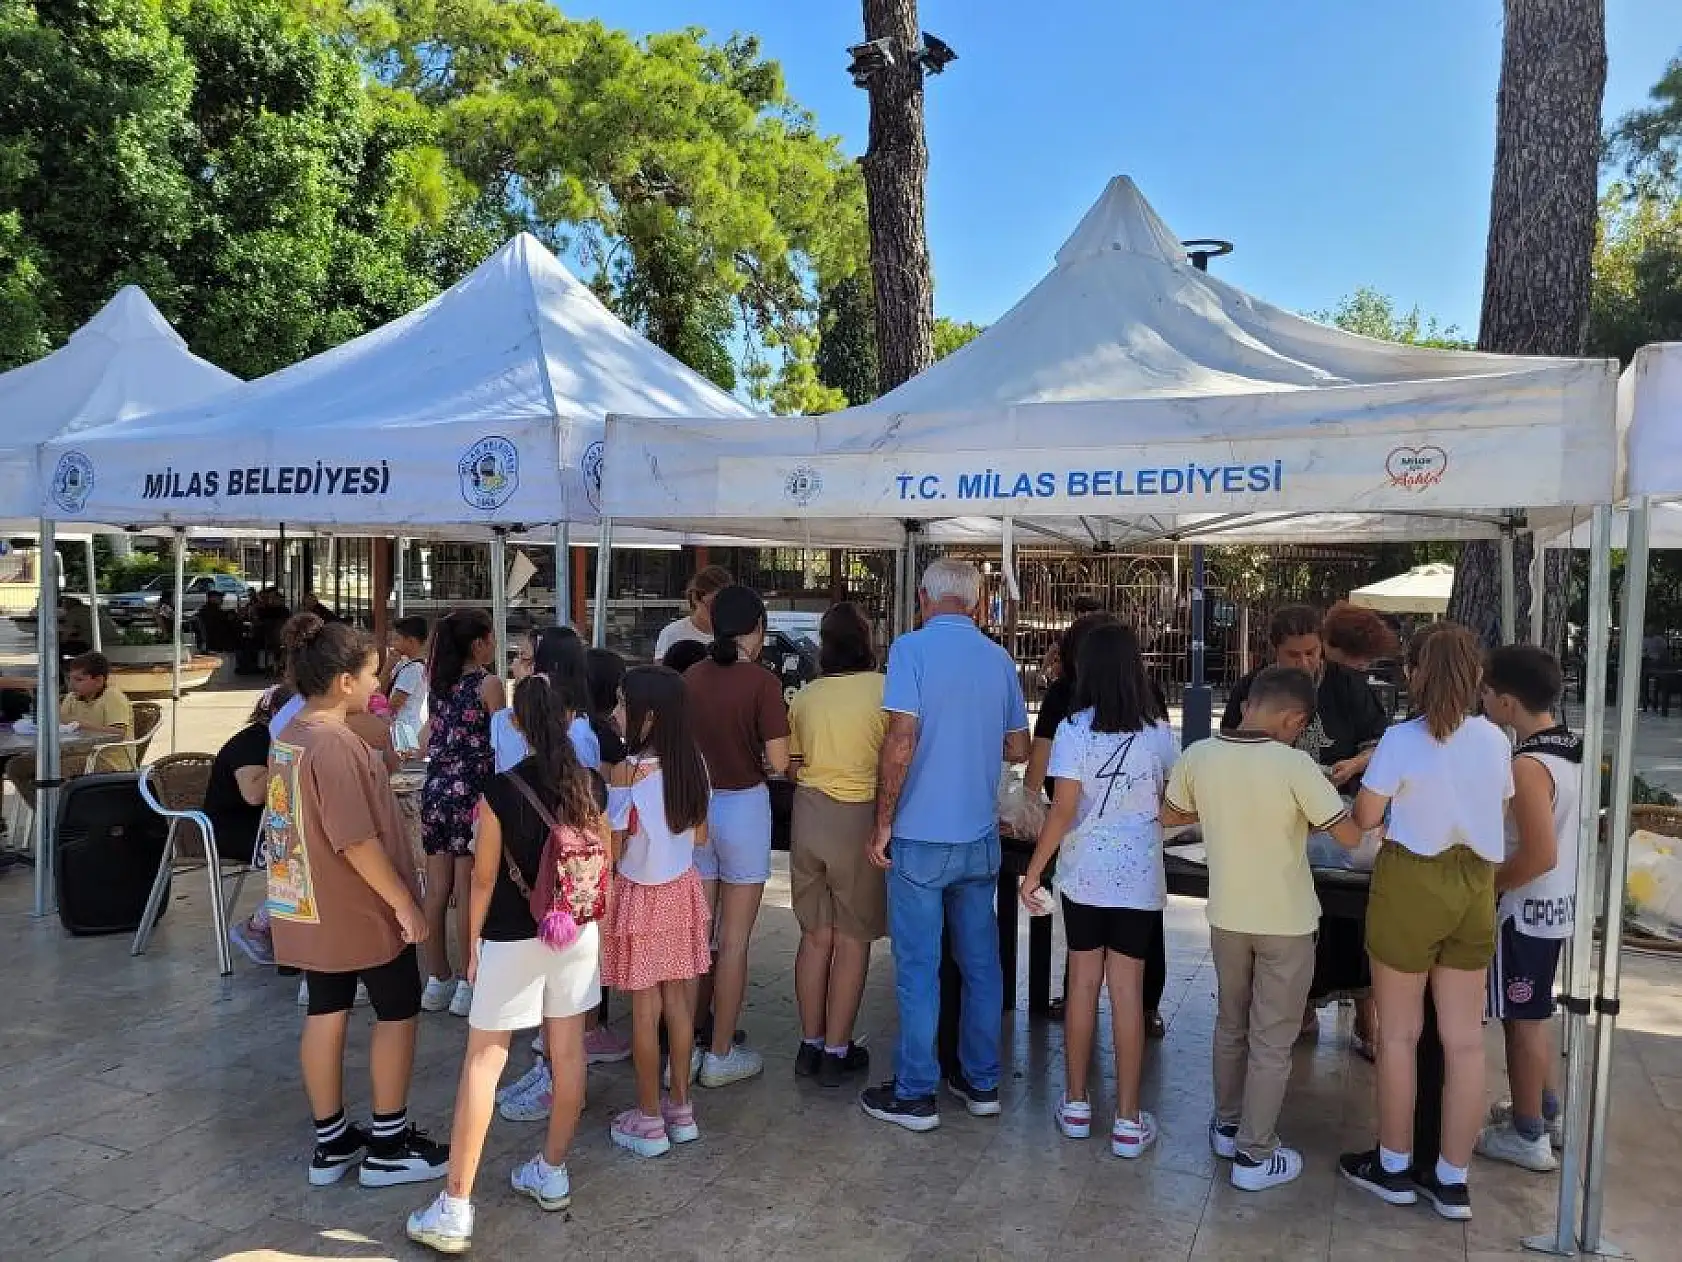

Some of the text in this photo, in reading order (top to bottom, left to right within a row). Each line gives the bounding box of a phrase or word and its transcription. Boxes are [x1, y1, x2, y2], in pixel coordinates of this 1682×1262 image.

[143, 459, 390, 499] MİLAS BELEDİYESİ
[896, 459, 1282, 499] T.C. MİLAS BELEDİYESİ
